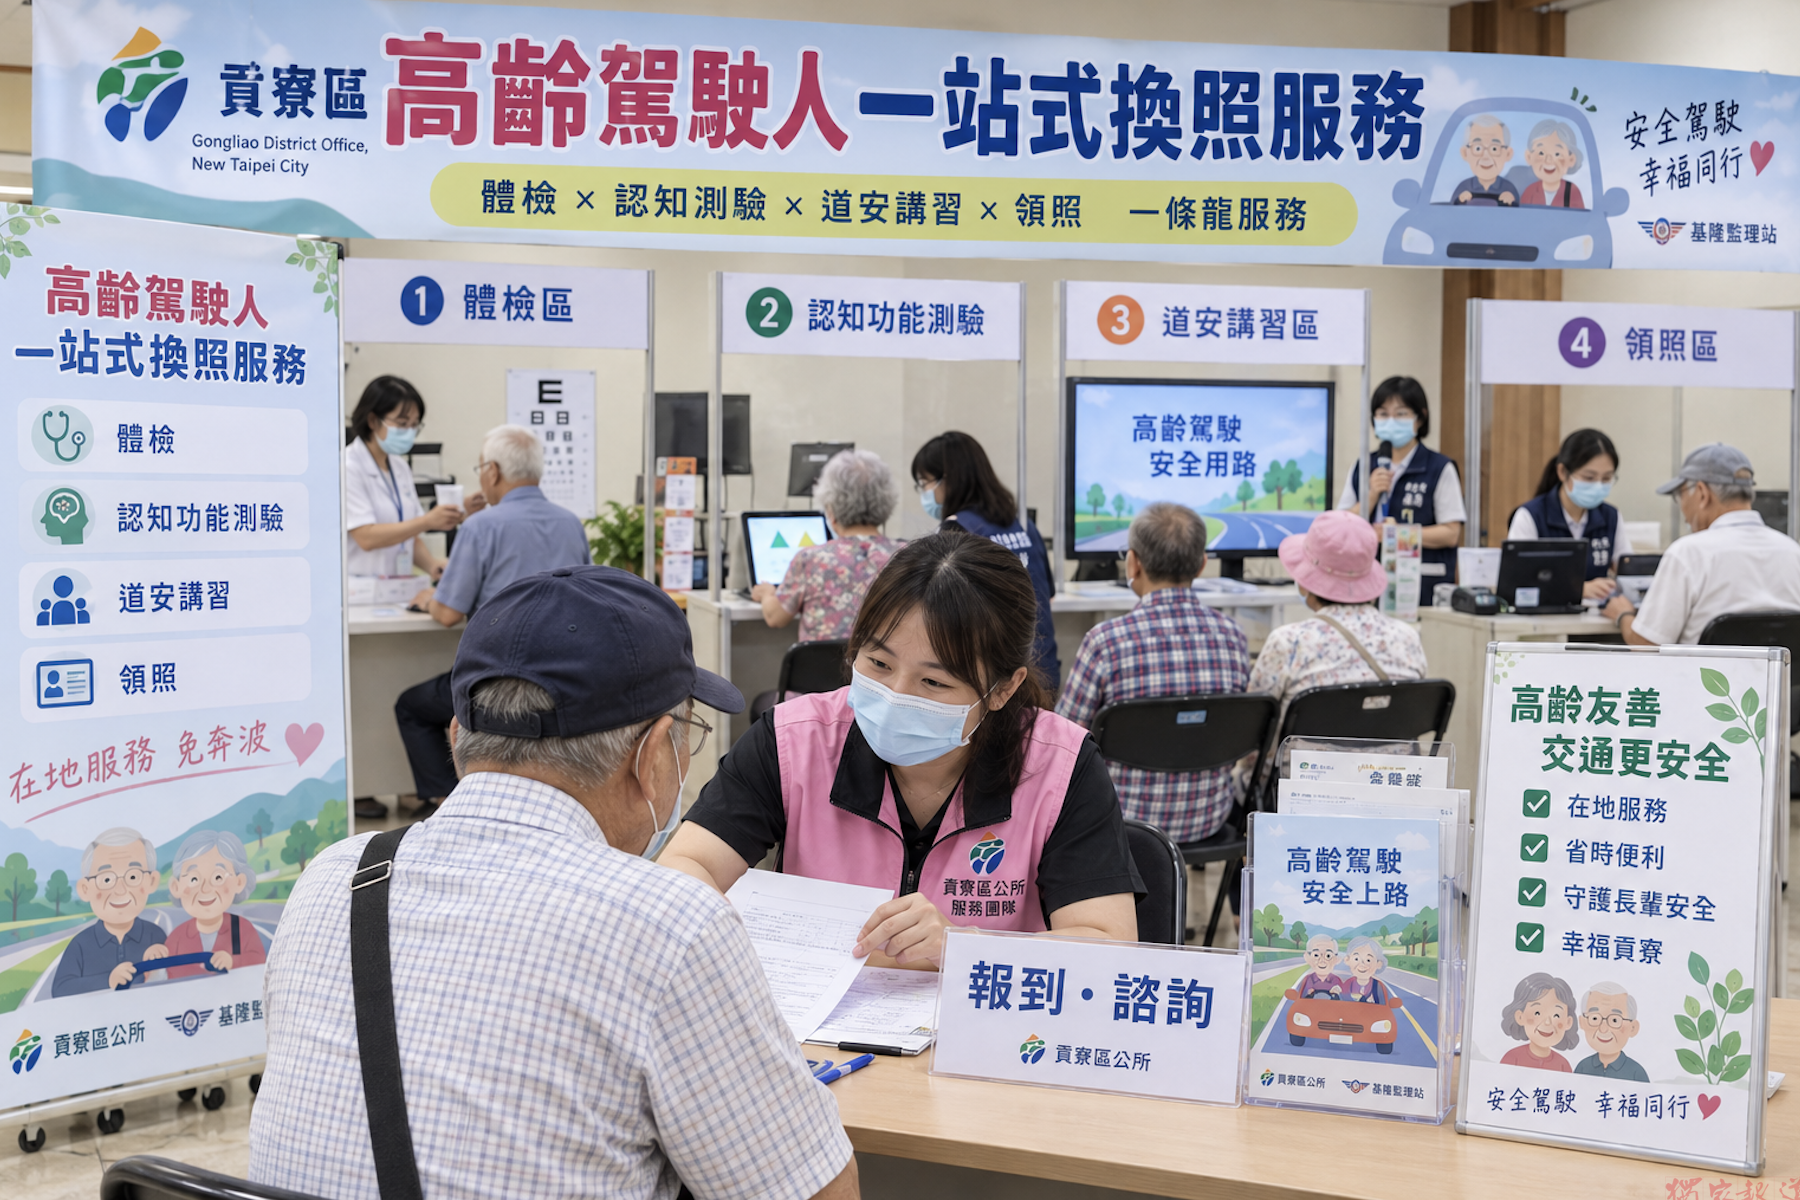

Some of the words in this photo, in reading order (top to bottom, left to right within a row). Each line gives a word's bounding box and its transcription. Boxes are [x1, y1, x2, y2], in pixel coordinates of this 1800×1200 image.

[220, 61, 367, 119] 貢寮區
[386, 32, 1424, 160] 高齡駕駛人一站式換照服務
[1624, 99, 1742, 151] 安全駕駛
[192, 134, 259, 152] Gongliao
[264, 136, 316, 151] District
[322, 138, 368, 154] Office,
[193, 157, 225, 170] New
[230, 158, 275, 175] Taipei
[280, 159, 309, 176] City
[1639, 147, 1743, 197] 幸福同行
[482, 179, 556, 215] 體檢
[615, 183, 766, 220] 認知測驗
[821, 190, 960, 225] 道安講習
[1015, 193, 1081, 228] 領照
[1130, 196, 1306, 231] 一條龍服務
[1691, 222, 1776, 244] 基隆監理站
[47, 265, 268, 328] 高齡駕駛人
[415, 286, 426, 316] 1
[464, 284, 573, 322] 體檢區
[760, 297, 778, 327] 2
[808, 299, 984, 335] 認知功能測驗
[1110, 304, 1130, 335] 3
[1163, 306, 1318, 340] 道安講習區
[15, 328, 306, 385] 一站式換照服務
[1571, 327, 1591, 358] 4
[1625, 327, 1717, 362] 領照區
[538, 380, 562, 404] E
[117, 424, 174, 454] 體檢
[1133, 414, 1241, 443] 高齡駕駛
[1150, 450, 1256, 477] 安全用路
[117, 503, 283, 532] 認知功能測驗
[119, 581, 228, 613] 道安講習
[120, 663, 176, 695] 領照
[1511, 685, 1660, 727] 高齡友善
[9, 736, 157, 804] 在地服務
[178, 719, 270, 767] 免奔波
[1541, 734, 1731, 783] 交通更安全
[1568, 794, 1667, 823] 在地服務
[1287, 847, 1401, 874] 高齡駕駛
[1565, 838, 1664, 870] 省時便利
[1303, 880, 1409, 907] 安全上路
[1564, 884, 1716, 922] 守護長輩安全
[1562, 931, 1662, 964] 幸福貢寮
[54, 1020, 145, 1059] 貢寮區公所
[1055, 1045, 1151, 1071] 貢寮區公所
[1487, 1087, 1577, 1114] 安全駕駛
[1595, 1091, 1690, 1119] 幸福同行
